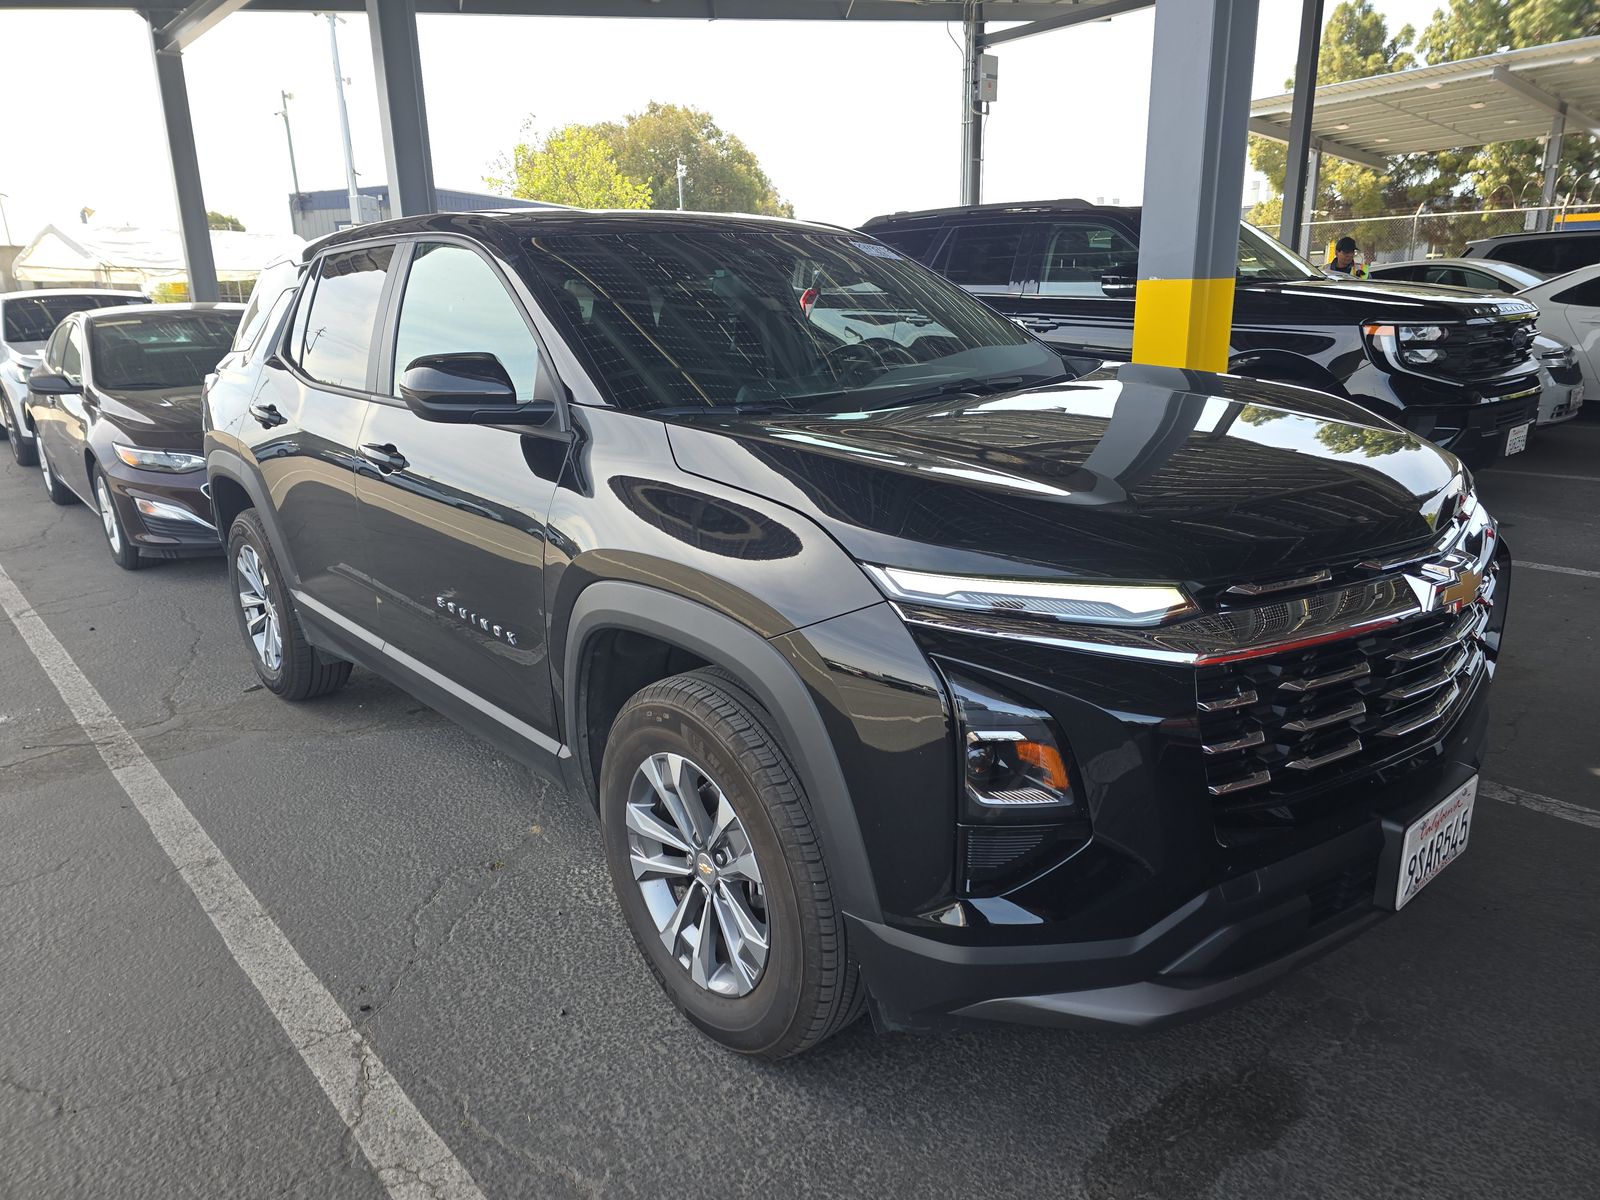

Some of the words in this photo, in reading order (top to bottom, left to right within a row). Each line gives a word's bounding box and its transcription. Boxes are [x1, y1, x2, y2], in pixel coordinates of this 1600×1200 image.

[436, 596, 517, 645] EQUINOX
[1420, 799, 1464, 840] California
[1404, 808, 1469, 896] 9SAR545
